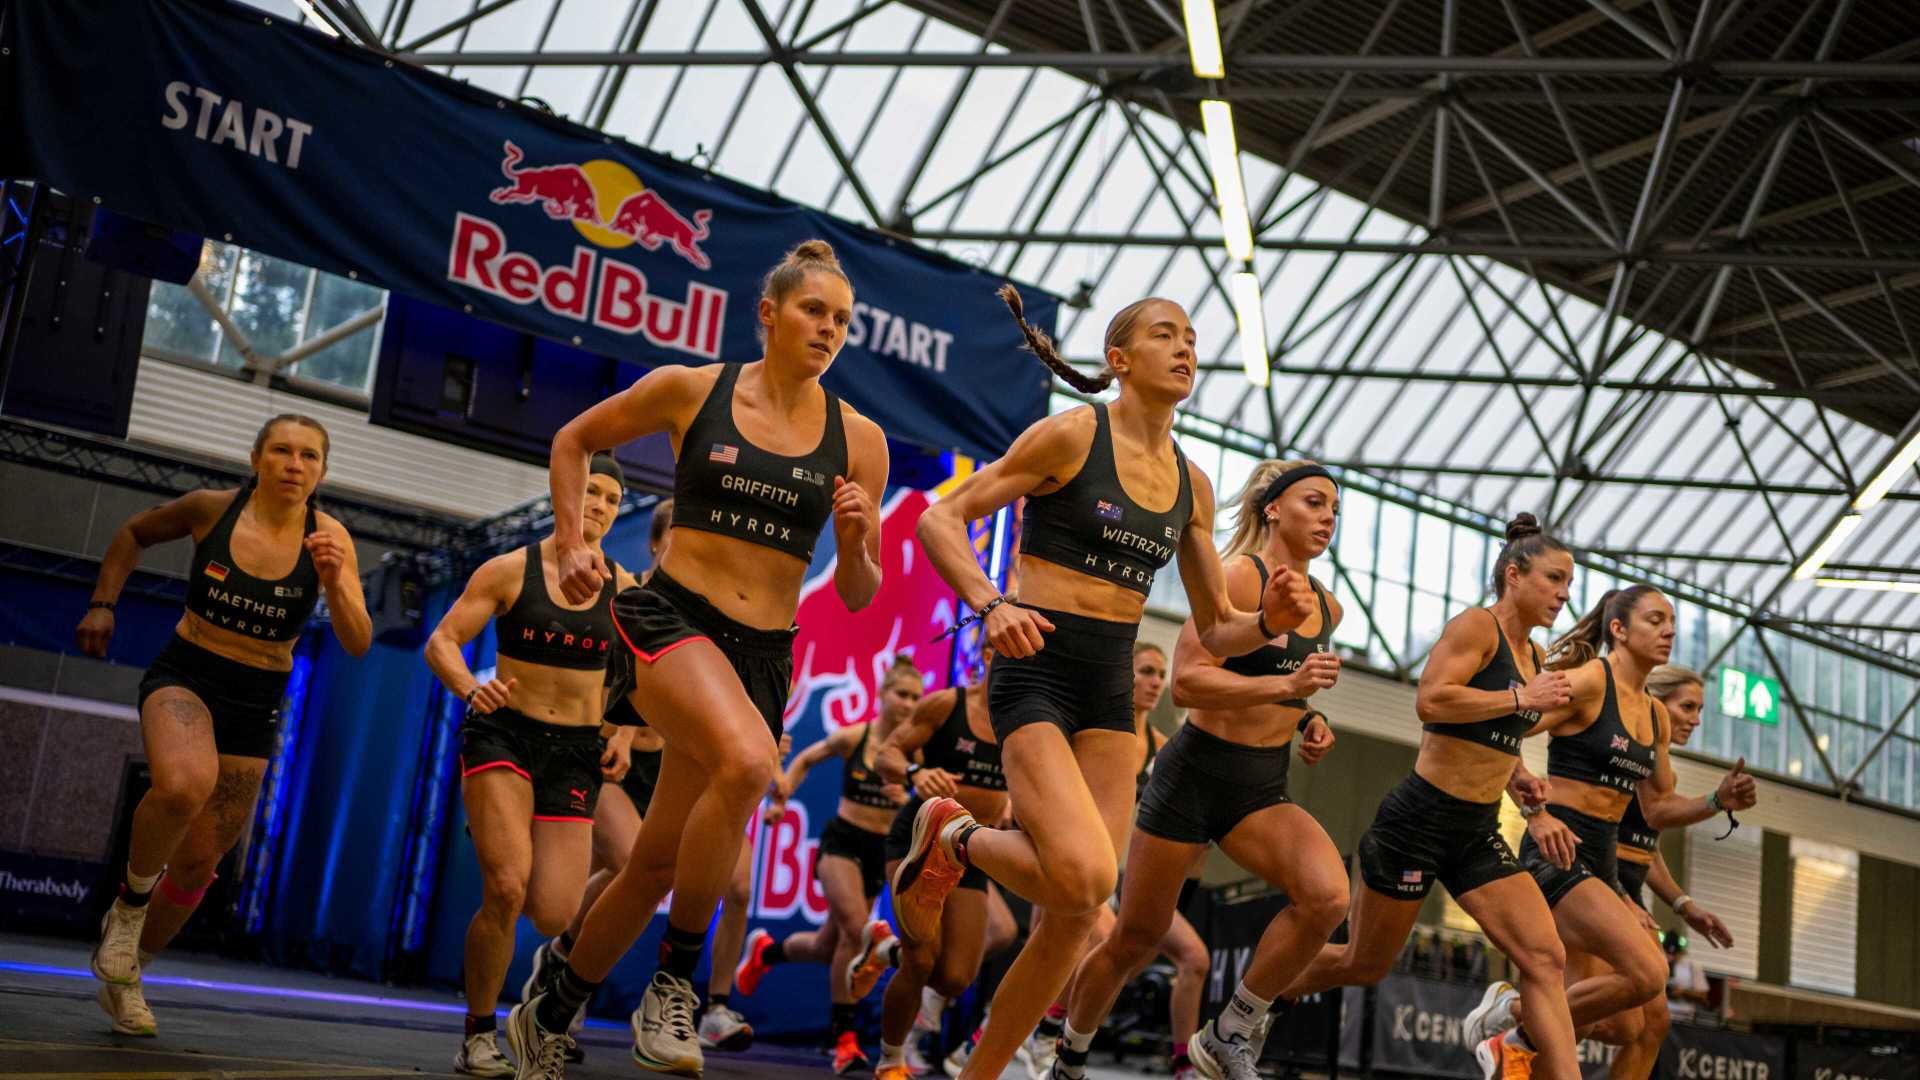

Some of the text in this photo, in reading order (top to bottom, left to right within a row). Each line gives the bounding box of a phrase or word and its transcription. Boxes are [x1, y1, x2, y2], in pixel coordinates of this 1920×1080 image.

[161, 81, 313, 169] START
[847, 302, 954, 373] START
[721, 474, 799, 507] GRIFFITH
[710, 510, 791, 541] HYROX
[1103, 525, 1171, 561] WIETRZYK
[1085, 553, 1154, 587] HYROX
[208, 586, 287, 619] NAETHER
[206, 609, 278, 638] HYROX
[523, 628, 609, 652] HYROX
[1276, 659, 1301, 672] JAC
